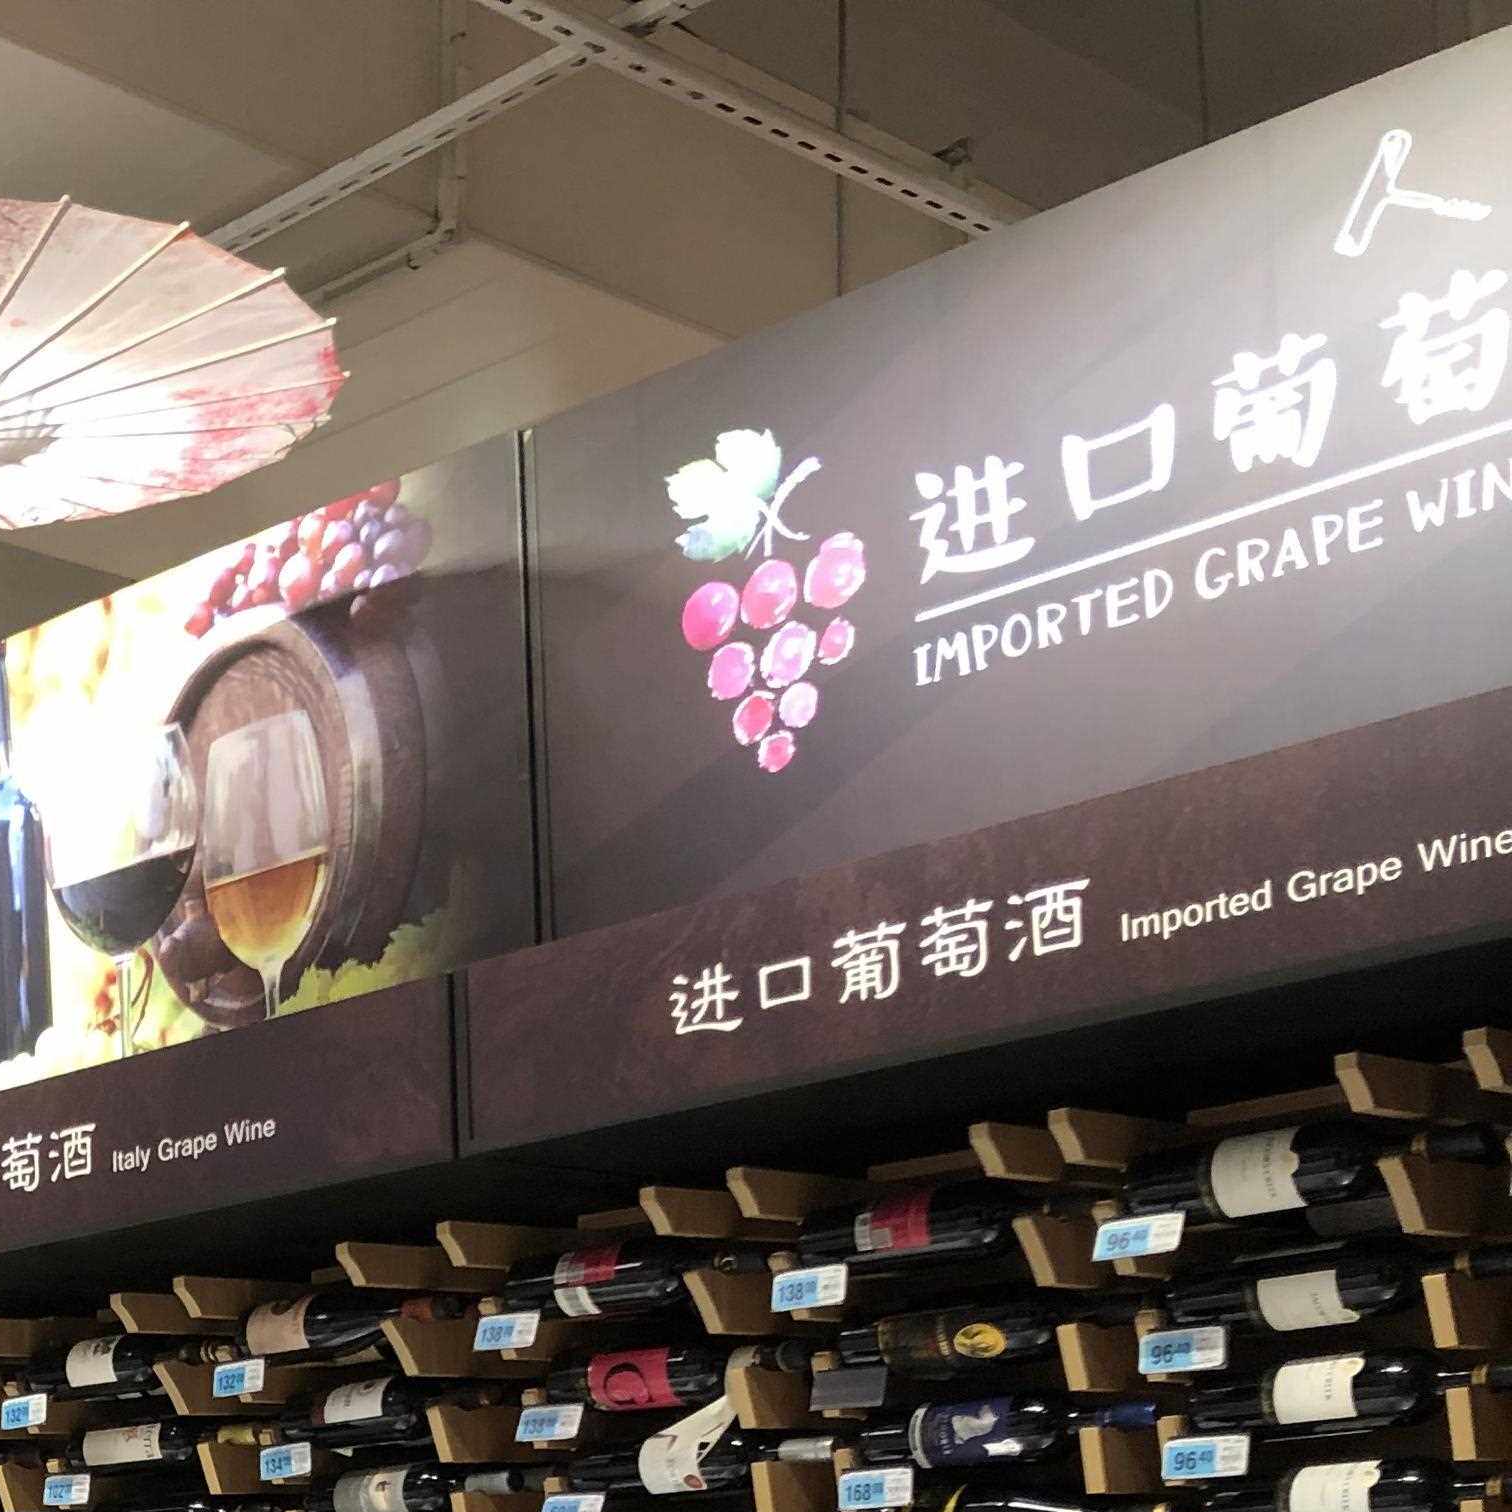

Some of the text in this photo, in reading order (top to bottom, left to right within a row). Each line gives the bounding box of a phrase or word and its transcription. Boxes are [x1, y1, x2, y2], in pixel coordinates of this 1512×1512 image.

[909, 269, 1509, 586] 进口葡萄
[914, 566, 1174, 687] IMPORTED
[1194, 497, 1385, 602] GRAPE
[669, 829, 1512, 1037] 进口葡萄酒 Imported Grape Wine
[112, 1146, 150, 1175] Italy
[158, 1132, 218, 1164] Grape
[224, 1117, 276, 1147] Wine
